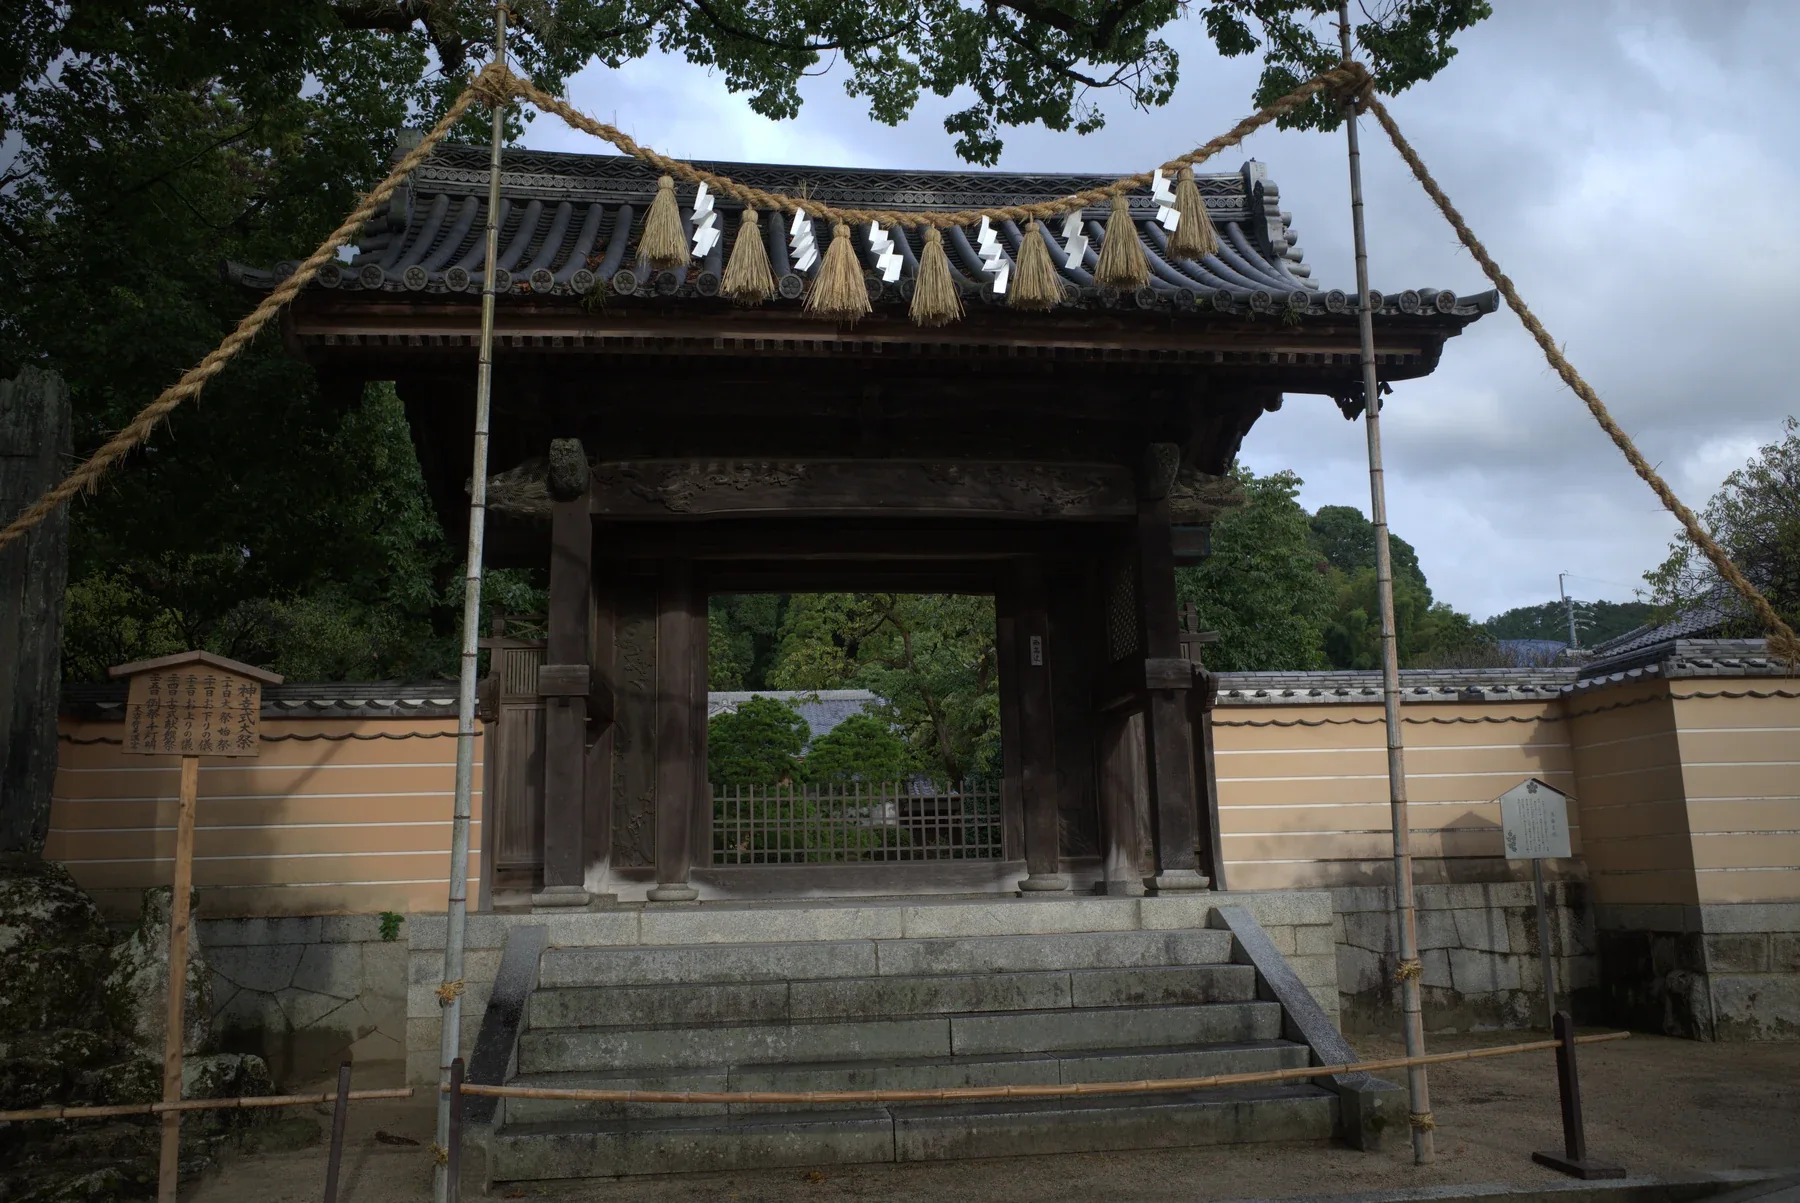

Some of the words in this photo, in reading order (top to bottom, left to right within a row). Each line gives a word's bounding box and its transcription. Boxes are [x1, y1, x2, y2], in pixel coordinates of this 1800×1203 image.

[217, 676, 234, 752] 二十日大祭始祭
[236, 682, 258, 750] 神幸式大祭
